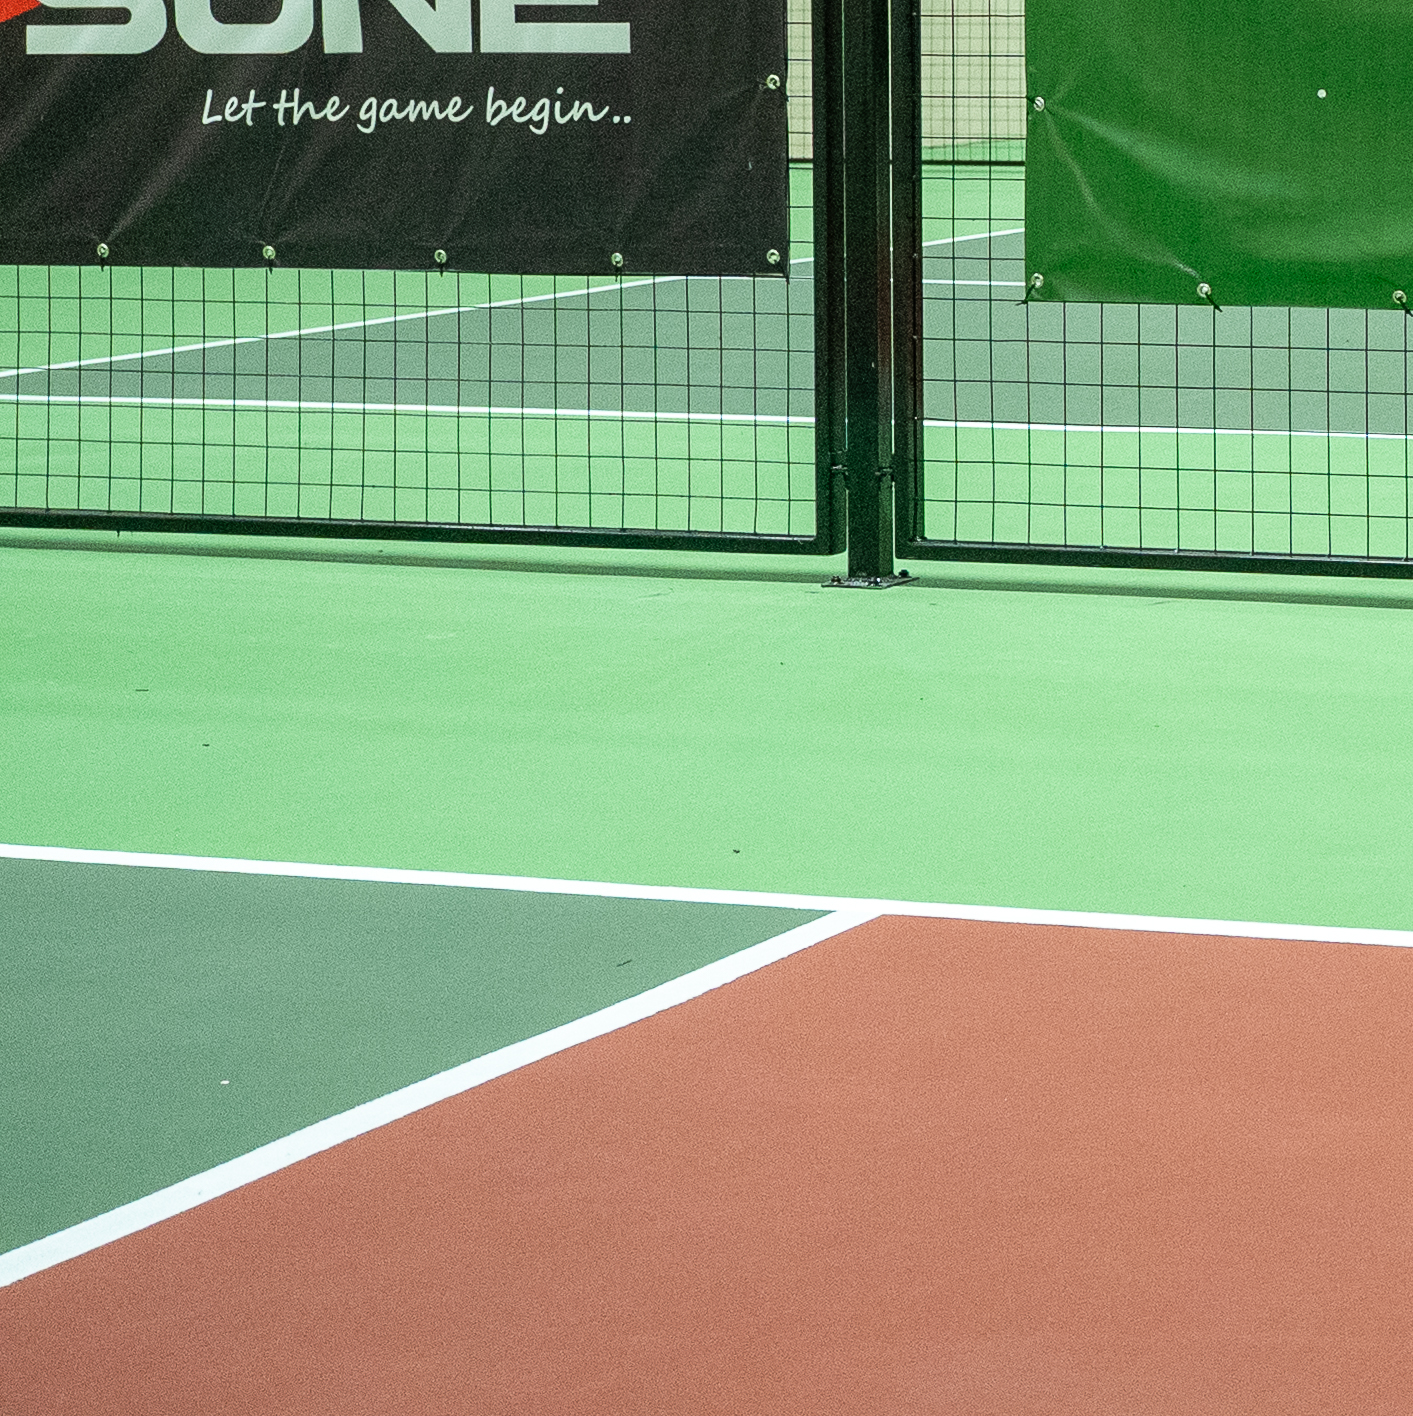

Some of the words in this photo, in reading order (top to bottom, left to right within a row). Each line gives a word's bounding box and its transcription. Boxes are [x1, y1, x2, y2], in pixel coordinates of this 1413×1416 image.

[201, 86, 269, 127] Let
[272, 87, 350, 127] the
[356, 96, 475, 134] game
[485, 85, 633, 136] begin..
